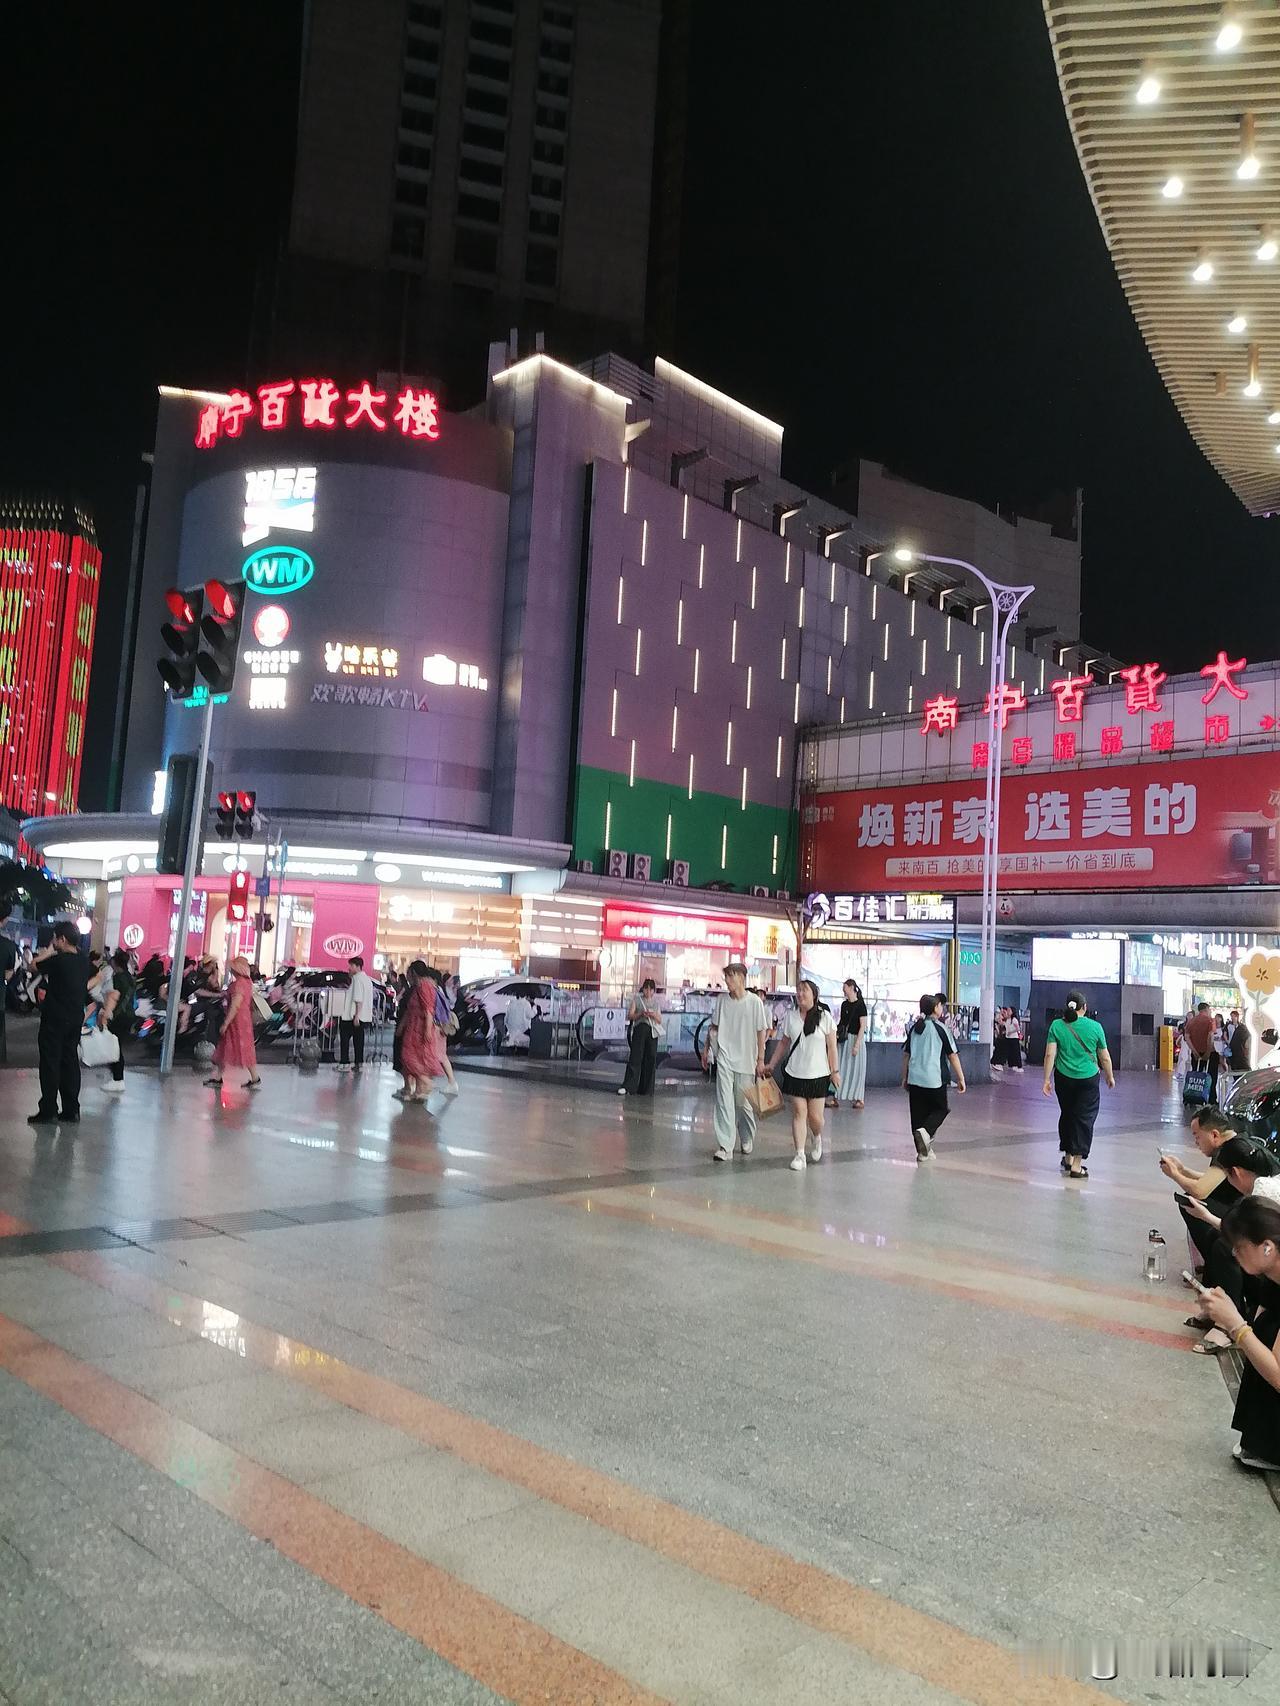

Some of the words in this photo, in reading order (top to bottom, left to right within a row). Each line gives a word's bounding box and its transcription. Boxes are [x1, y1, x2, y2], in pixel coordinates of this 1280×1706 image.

[252, 557, 303, 584] WM
[858, 797, 996, 848] 焕新家
[1024, 782, 1196, 841] 选美的
[898, 860, 939, 875] 来南百
[834, 895, 905, 922] 百佳汇
